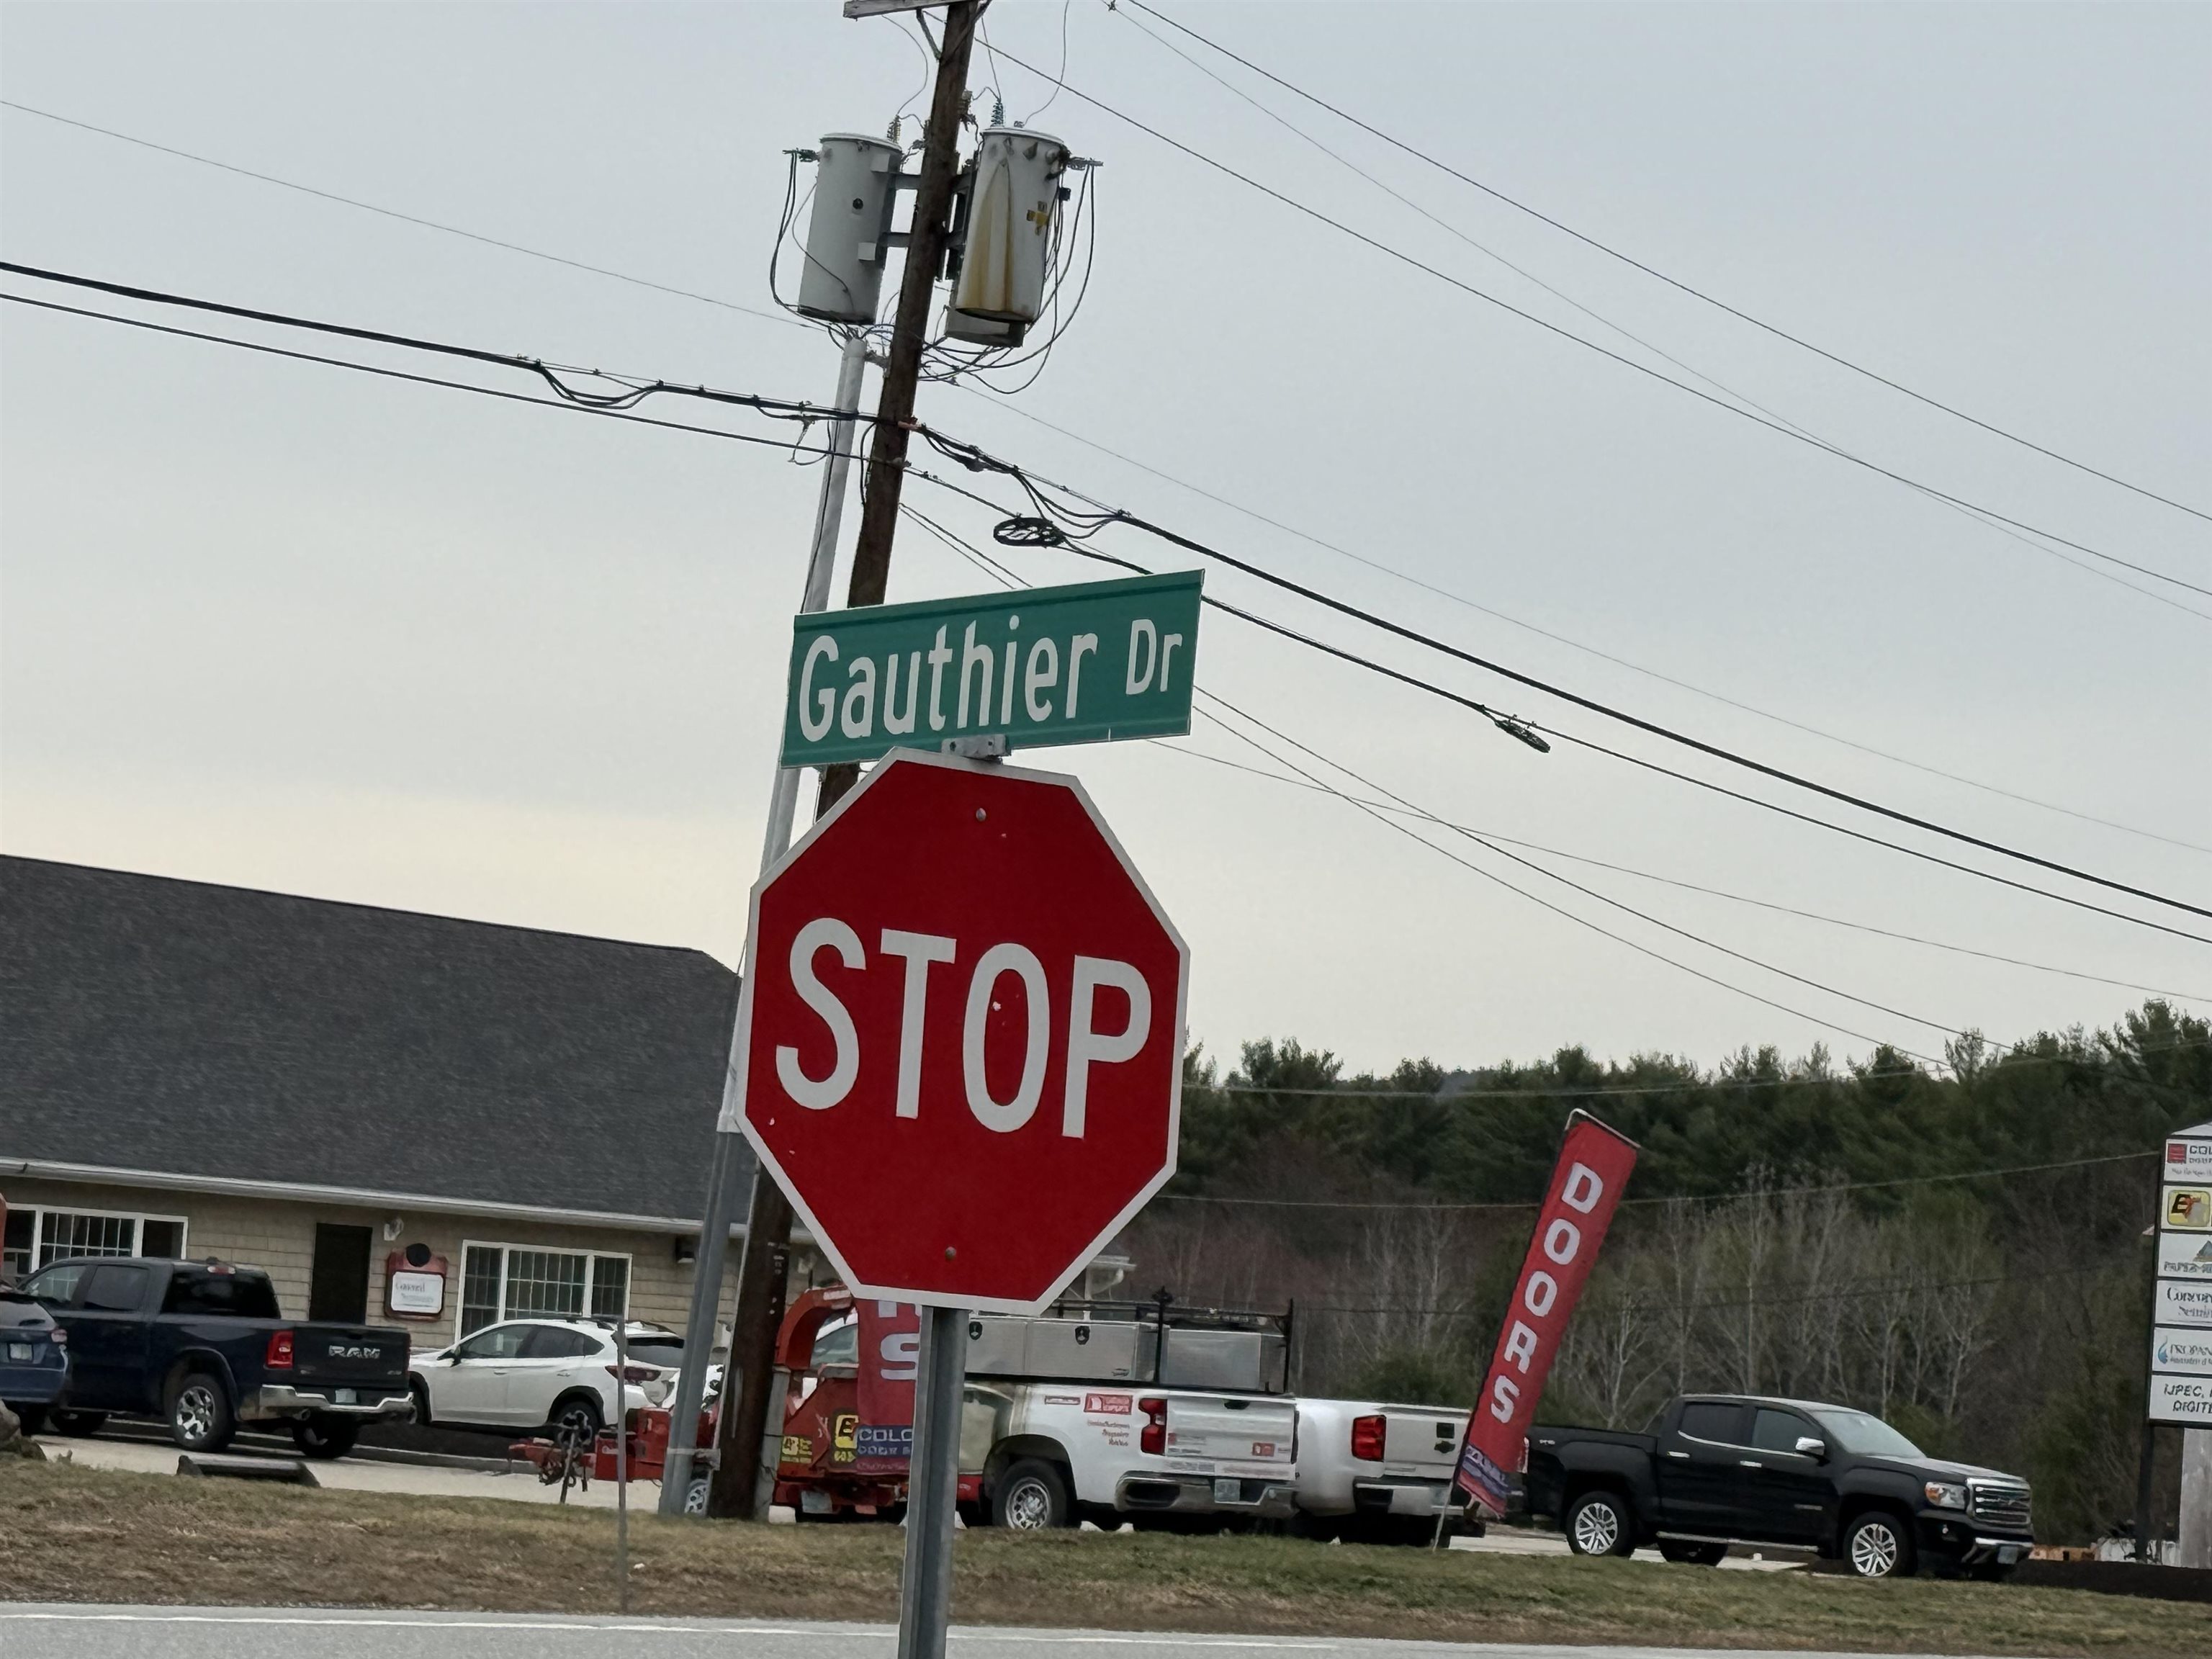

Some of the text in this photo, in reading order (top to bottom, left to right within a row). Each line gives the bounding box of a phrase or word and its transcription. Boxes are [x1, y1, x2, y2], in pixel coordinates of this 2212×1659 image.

[799, 615, 1182, 742] Gauthier Dr
[776, 917, 1151, 1138] STOP
[328, 1345, 380, 1359] RAM
[1491, 1162, 1604, 1424] DOORS
